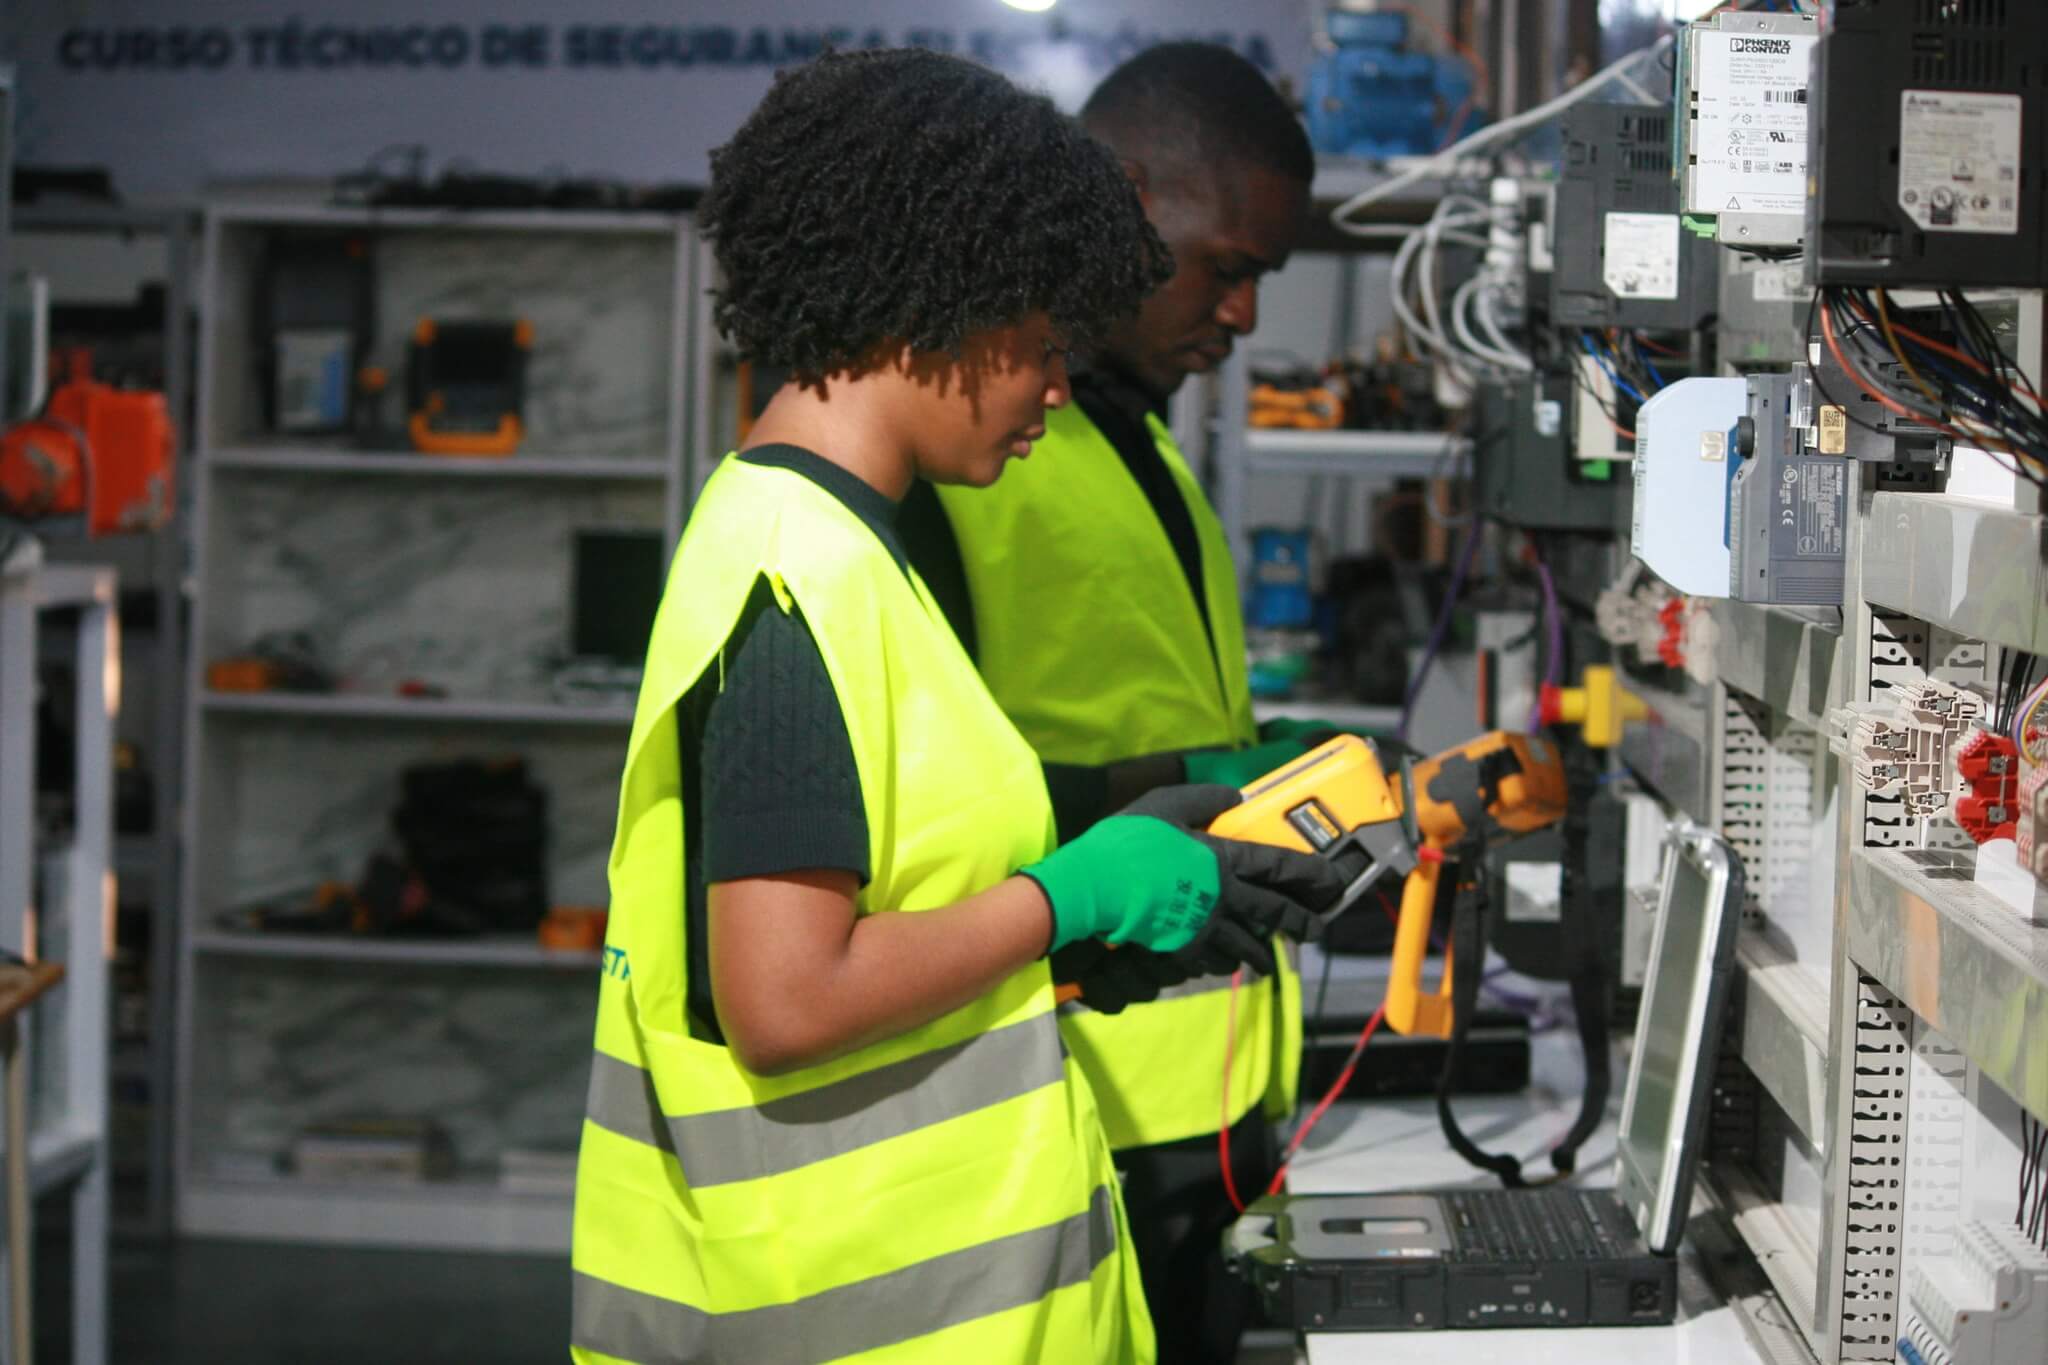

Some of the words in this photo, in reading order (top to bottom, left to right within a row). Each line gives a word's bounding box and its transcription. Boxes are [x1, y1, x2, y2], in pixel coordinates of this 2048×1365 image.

[59, 26, 234, 71] CURSO
[247, 13, 468, 70] TÉCNICO
[481, 24, 549, 69] DE
[1745, 46, 1791, 55] CONTACT
[1782, 509, 1794, 526] CE
